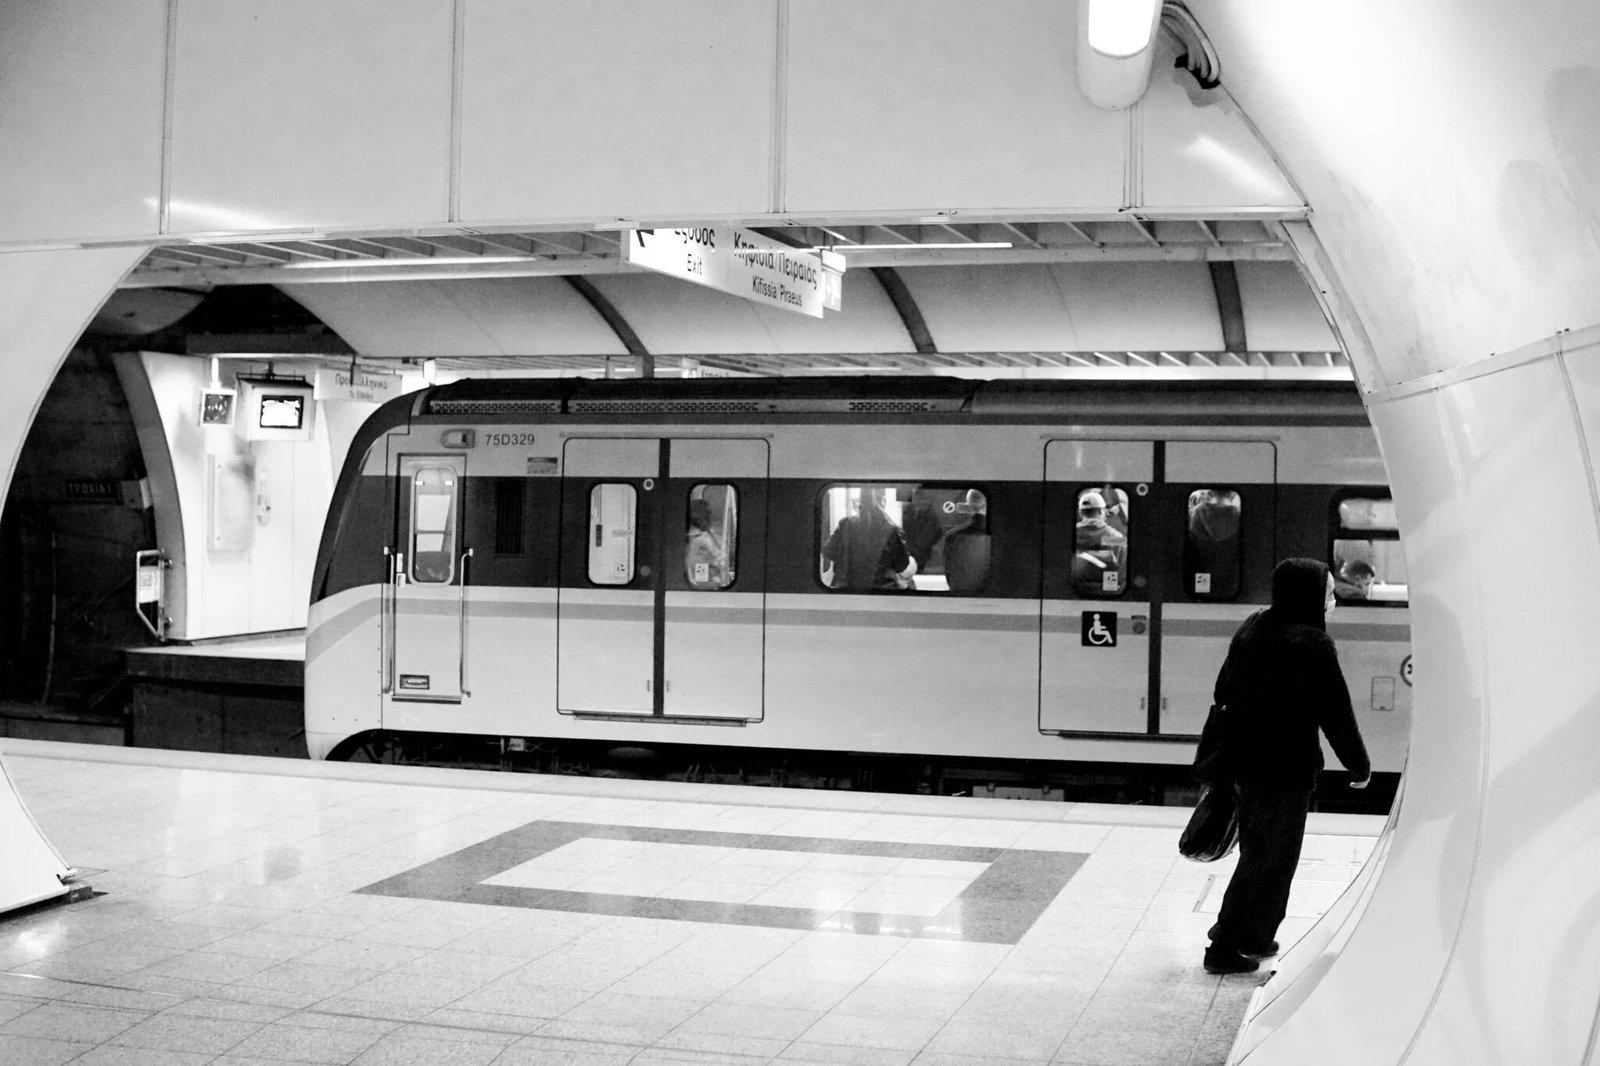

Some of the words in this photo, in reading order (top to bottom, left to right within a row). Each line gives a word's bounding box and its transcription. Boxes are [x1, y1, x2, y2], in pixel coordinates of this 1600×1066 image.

[674, 227, 715, 249] ξοδος
[687, 253, 703, 275] Exit
[752, 274, 777, 299] Kifissia
[780, 284, 802, 307] Piraeus
[485, 433, 535, 446] 75D329
